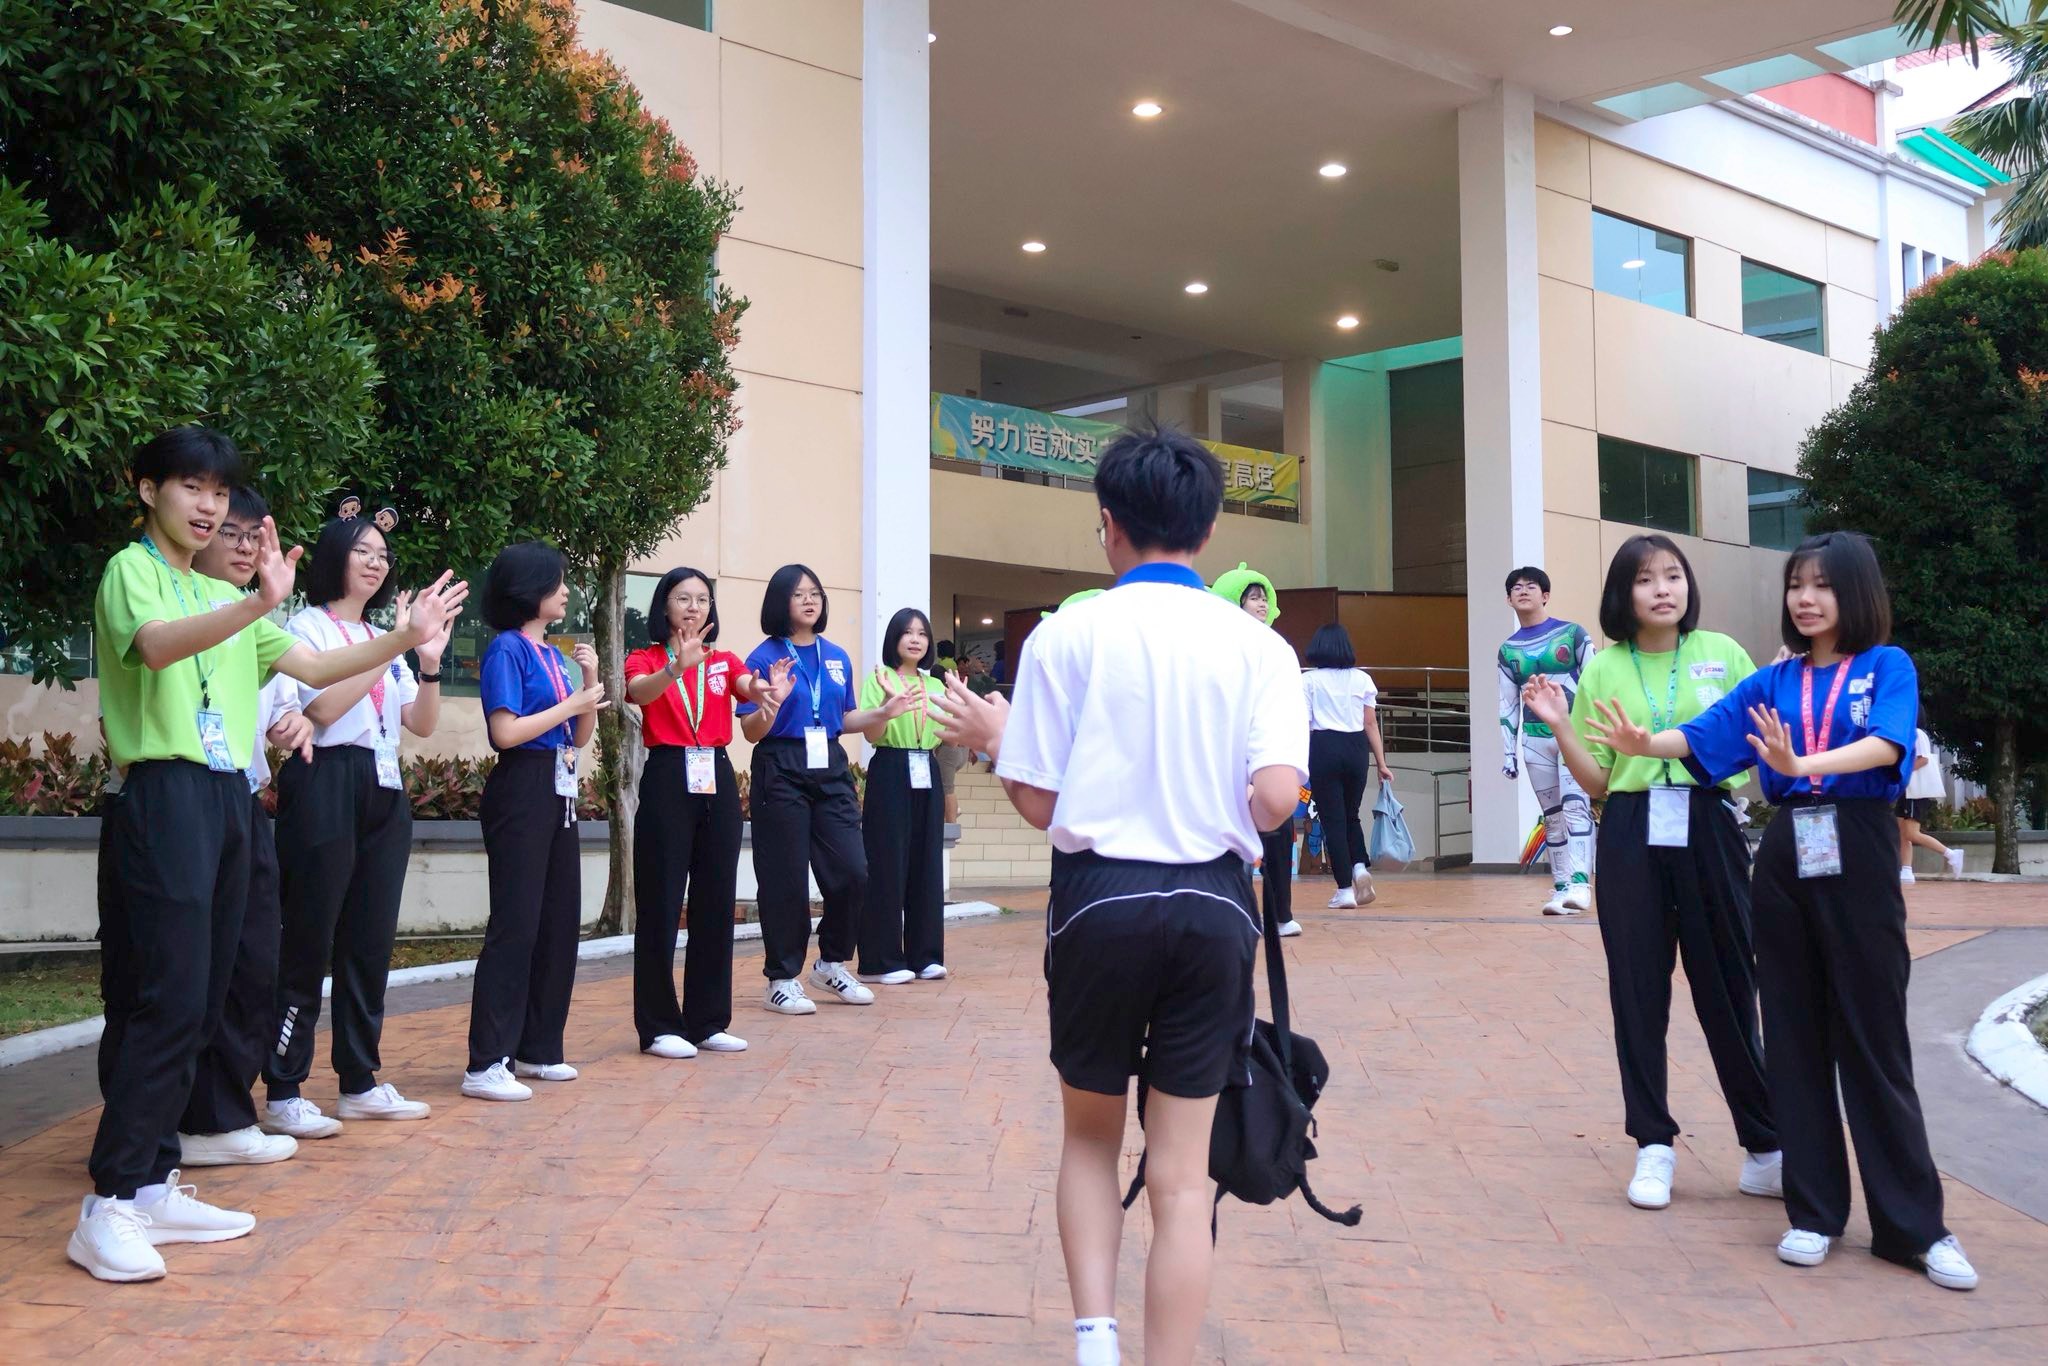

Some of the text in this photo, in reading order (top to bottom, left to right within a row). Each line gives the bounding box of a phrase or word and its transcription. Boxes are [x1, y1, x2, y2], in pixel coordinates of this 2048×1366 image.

[970, 411, 1110, 465] 努力造就实
